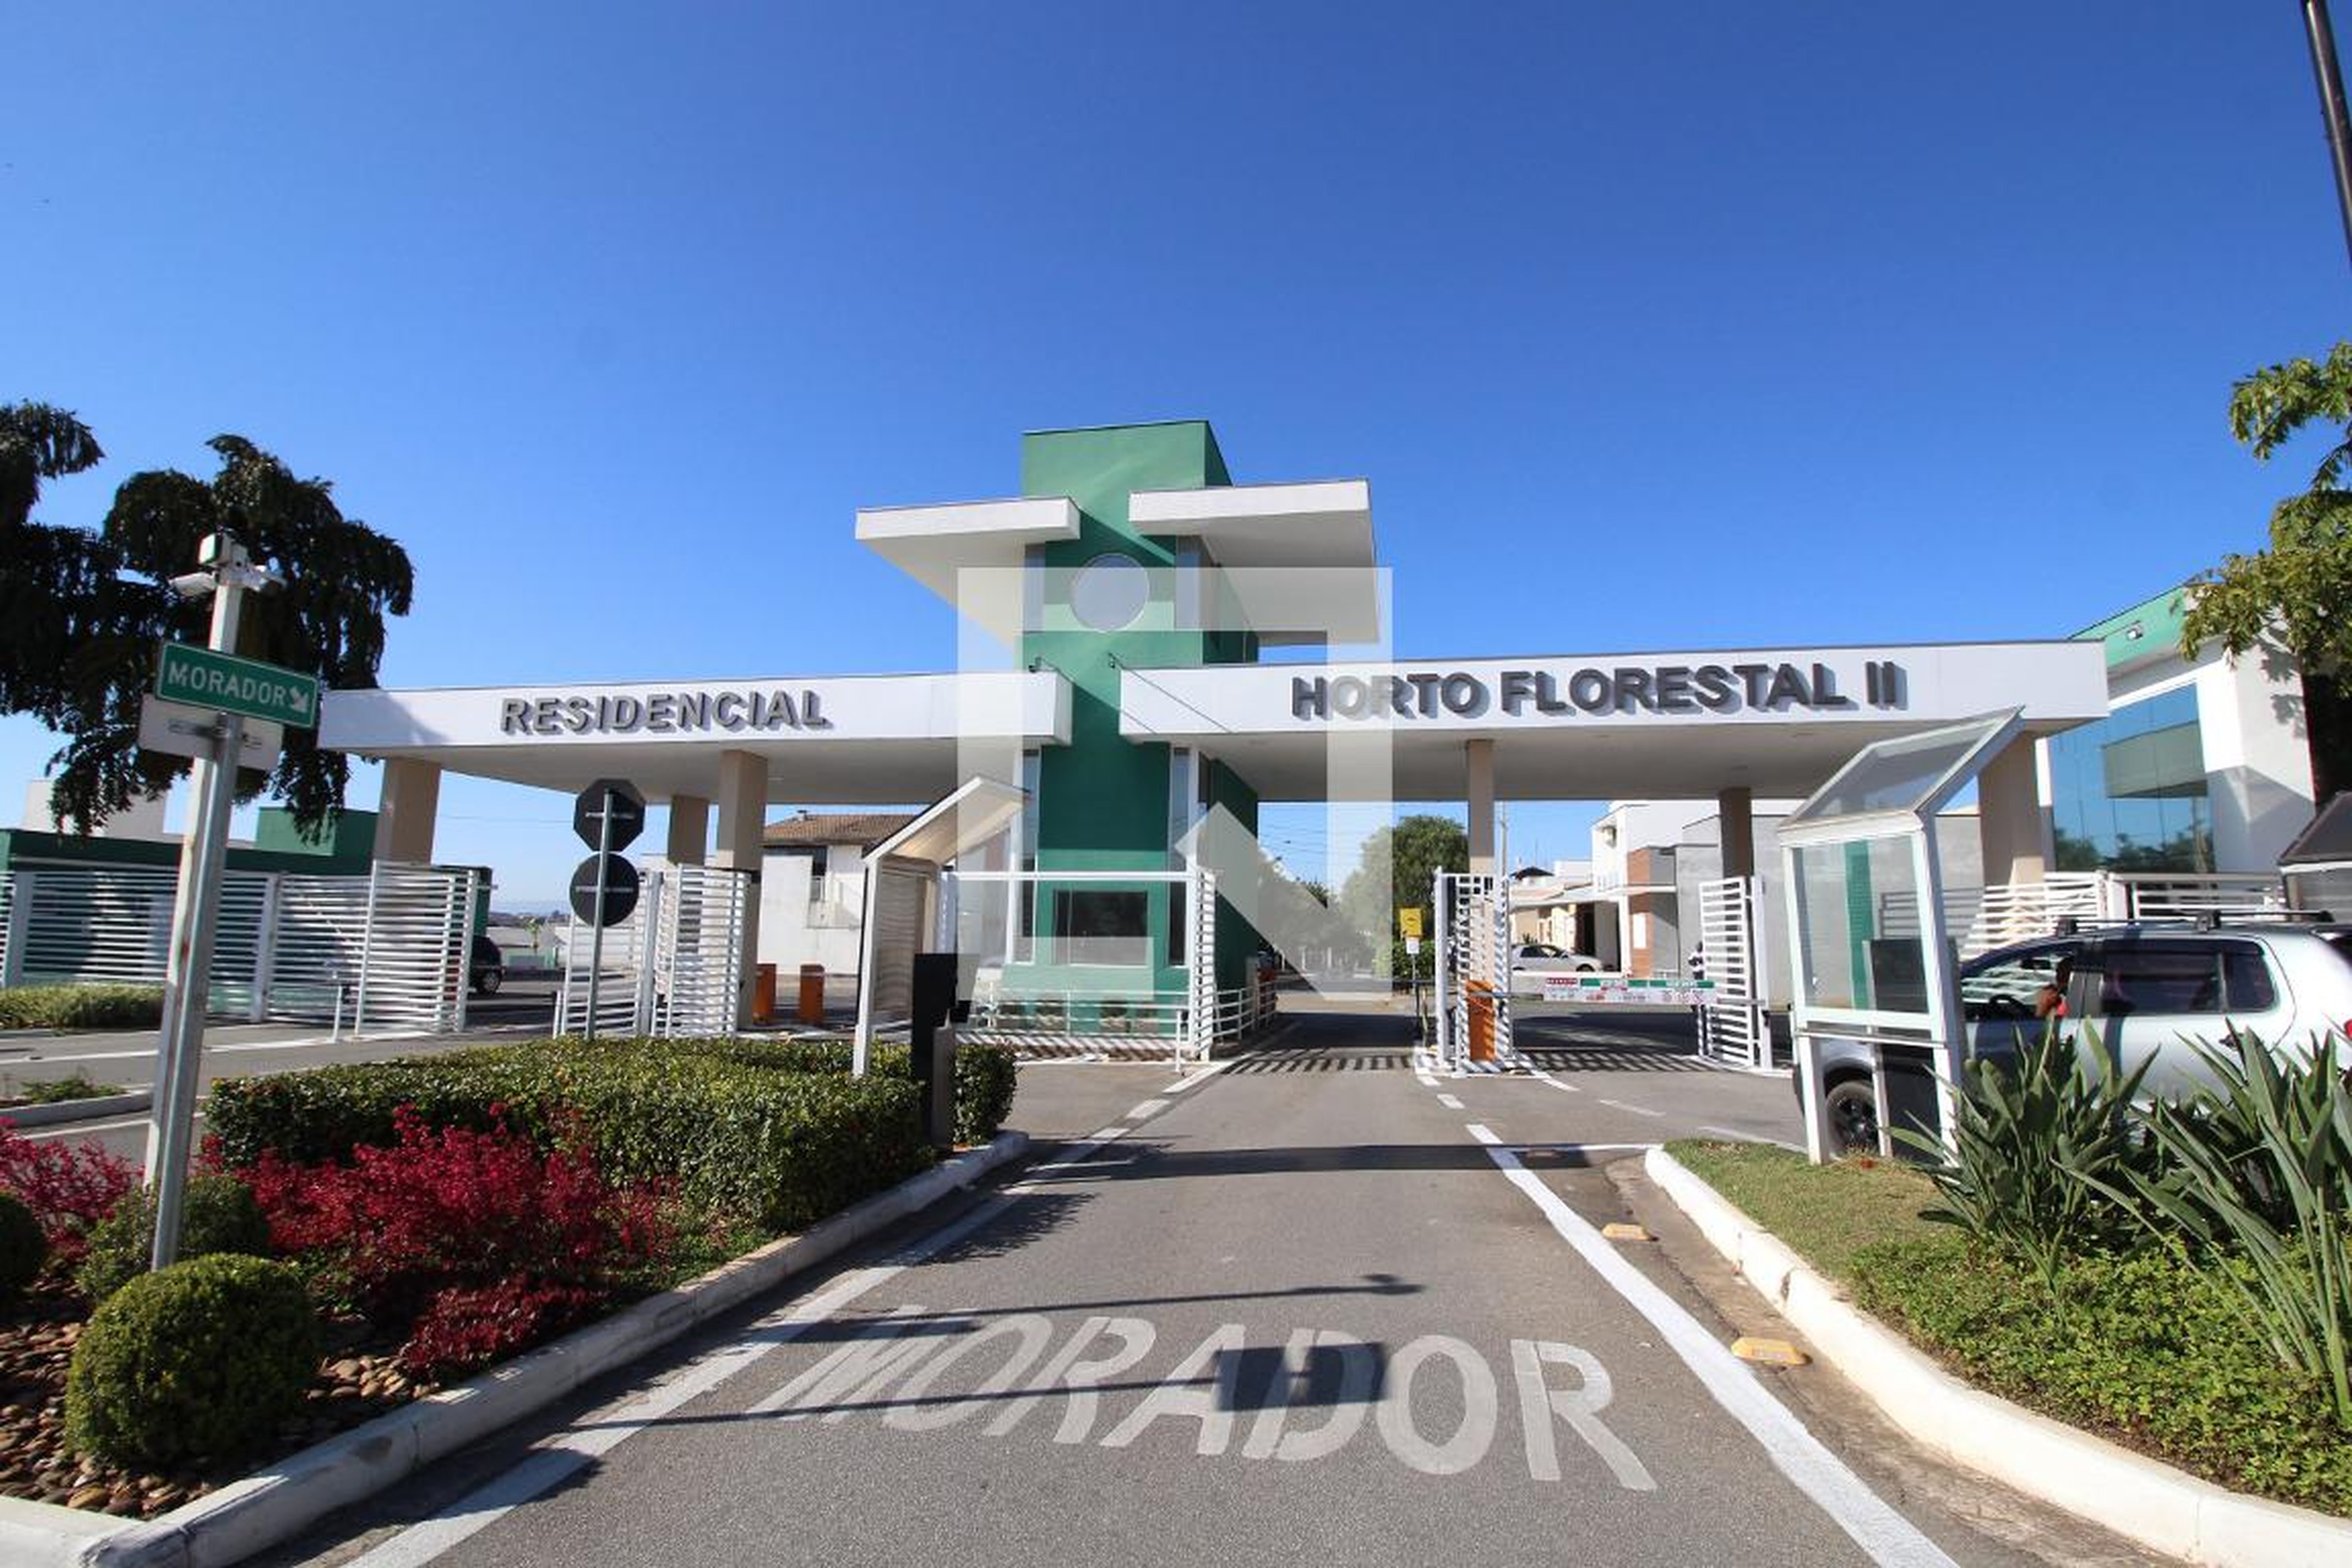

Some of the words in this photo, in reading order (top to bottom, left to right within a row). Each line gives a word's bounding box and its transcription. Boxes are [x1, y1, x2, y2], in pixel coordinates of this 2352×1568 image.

[168, 662, 287, 707] MORADOR
[1292, 672, 1480, 718] HORTO
[1501, 663, 1848, 715] FLORESTAL
[1865, 662, 1898, 706] II
[500, 690, 827, 733] RESIDENCIAL
[744, 1305, 1657, 1490] MORADOR
